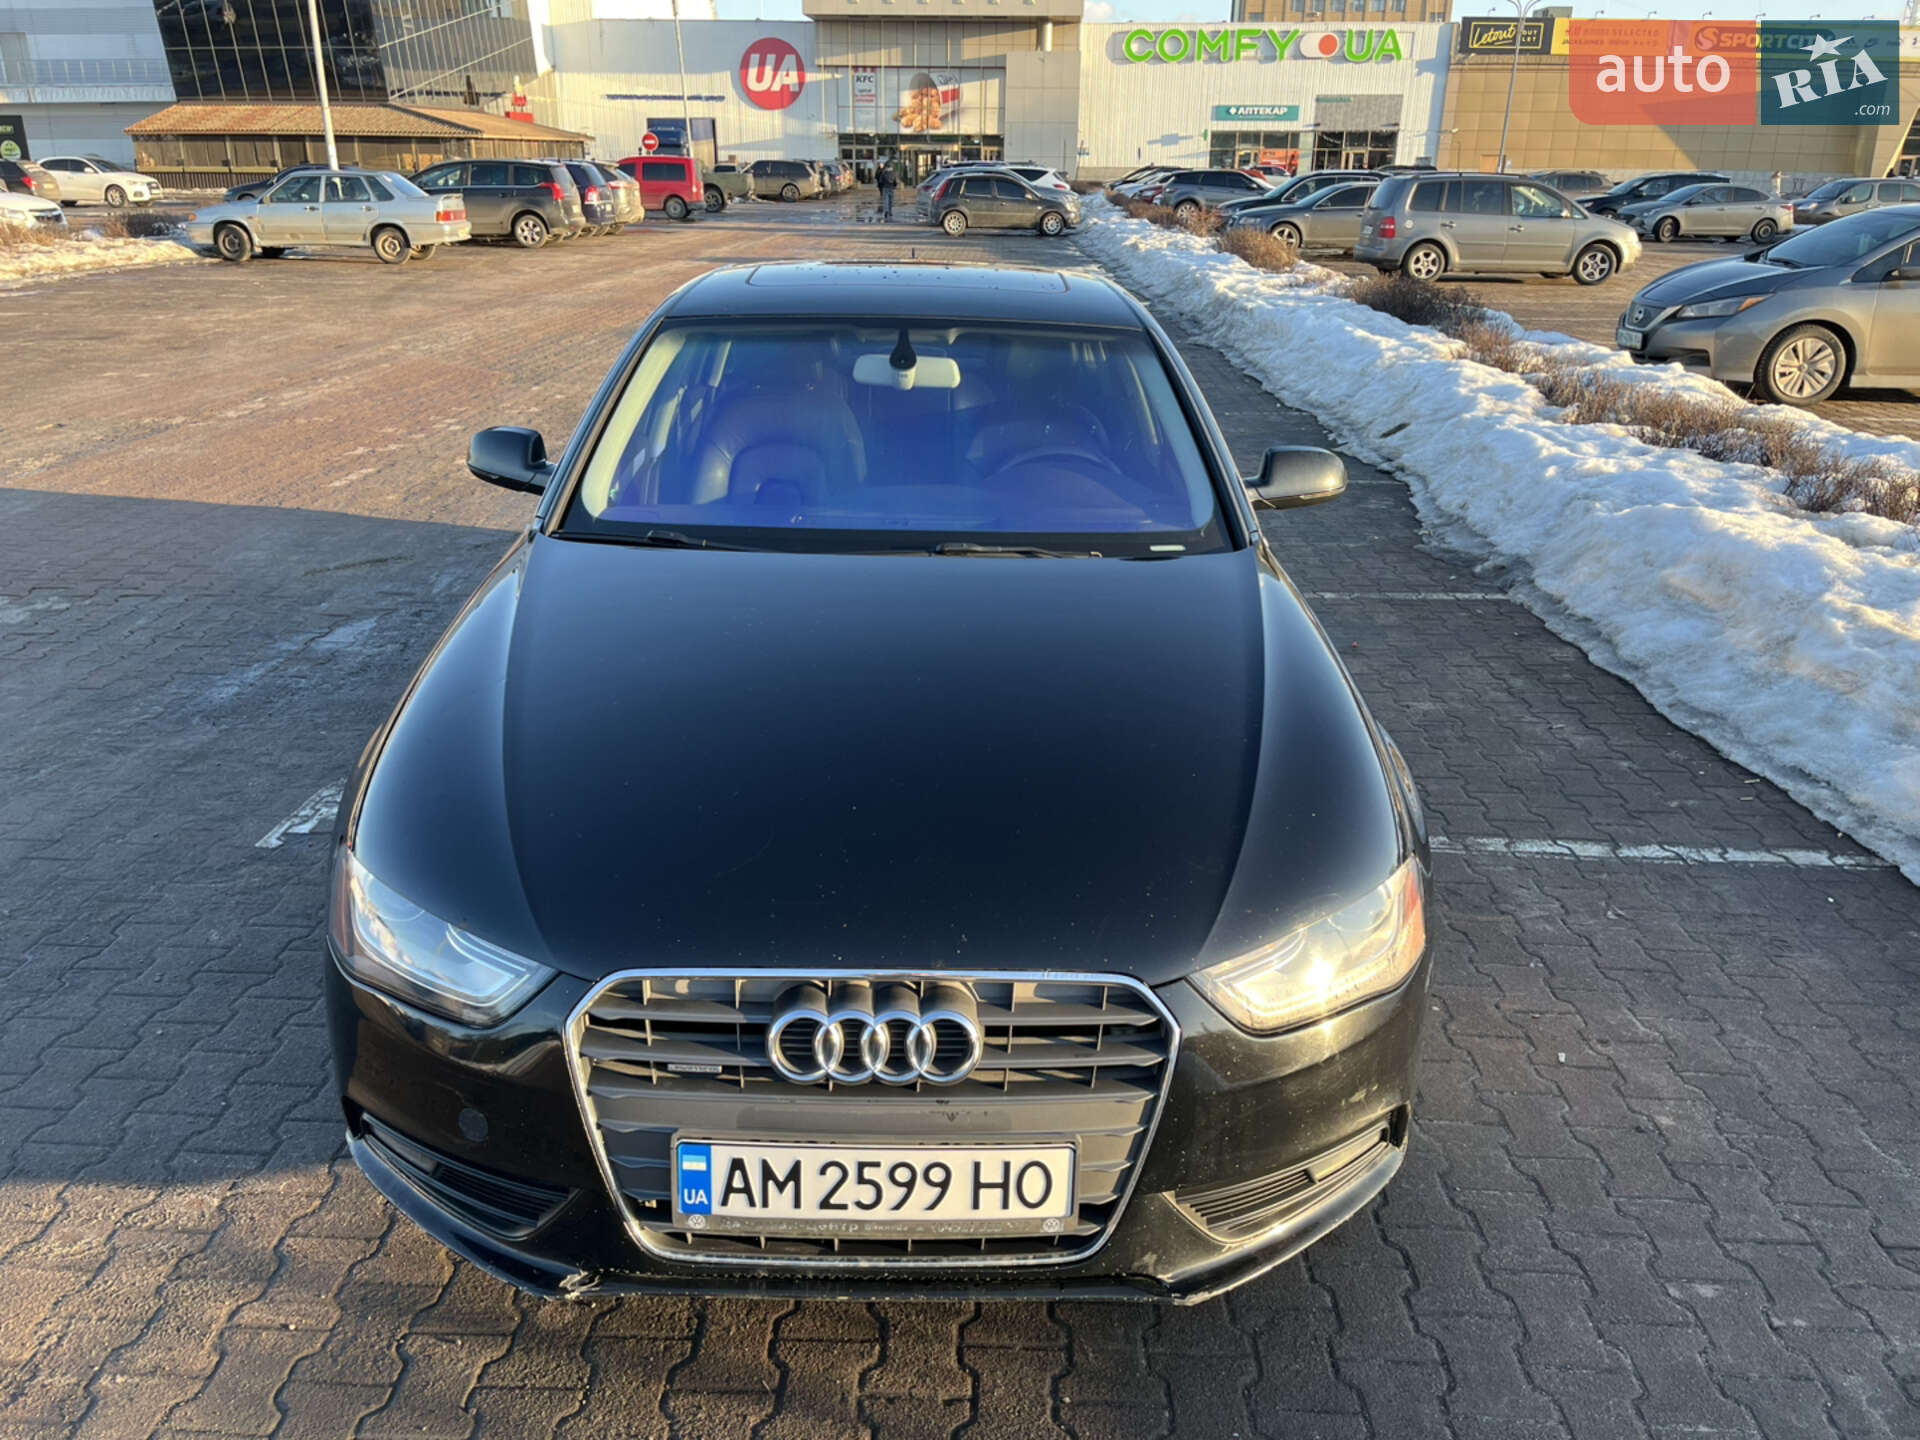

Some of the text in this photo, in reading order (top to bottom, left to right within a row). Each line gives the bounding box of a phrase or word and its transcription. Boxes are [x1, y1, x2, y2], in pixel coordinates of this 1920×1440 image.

[1124, 28, 1403, 62] COMFY UA
[746, 53, 800, 92] UA
[855, 75, 874, 84] KFC
[1238, 106, 1288, 116] АПТЕКАР
[683, 1188, 709, 1206] UA
[720, 1157, 1053, 1211] AM 2599 HO
